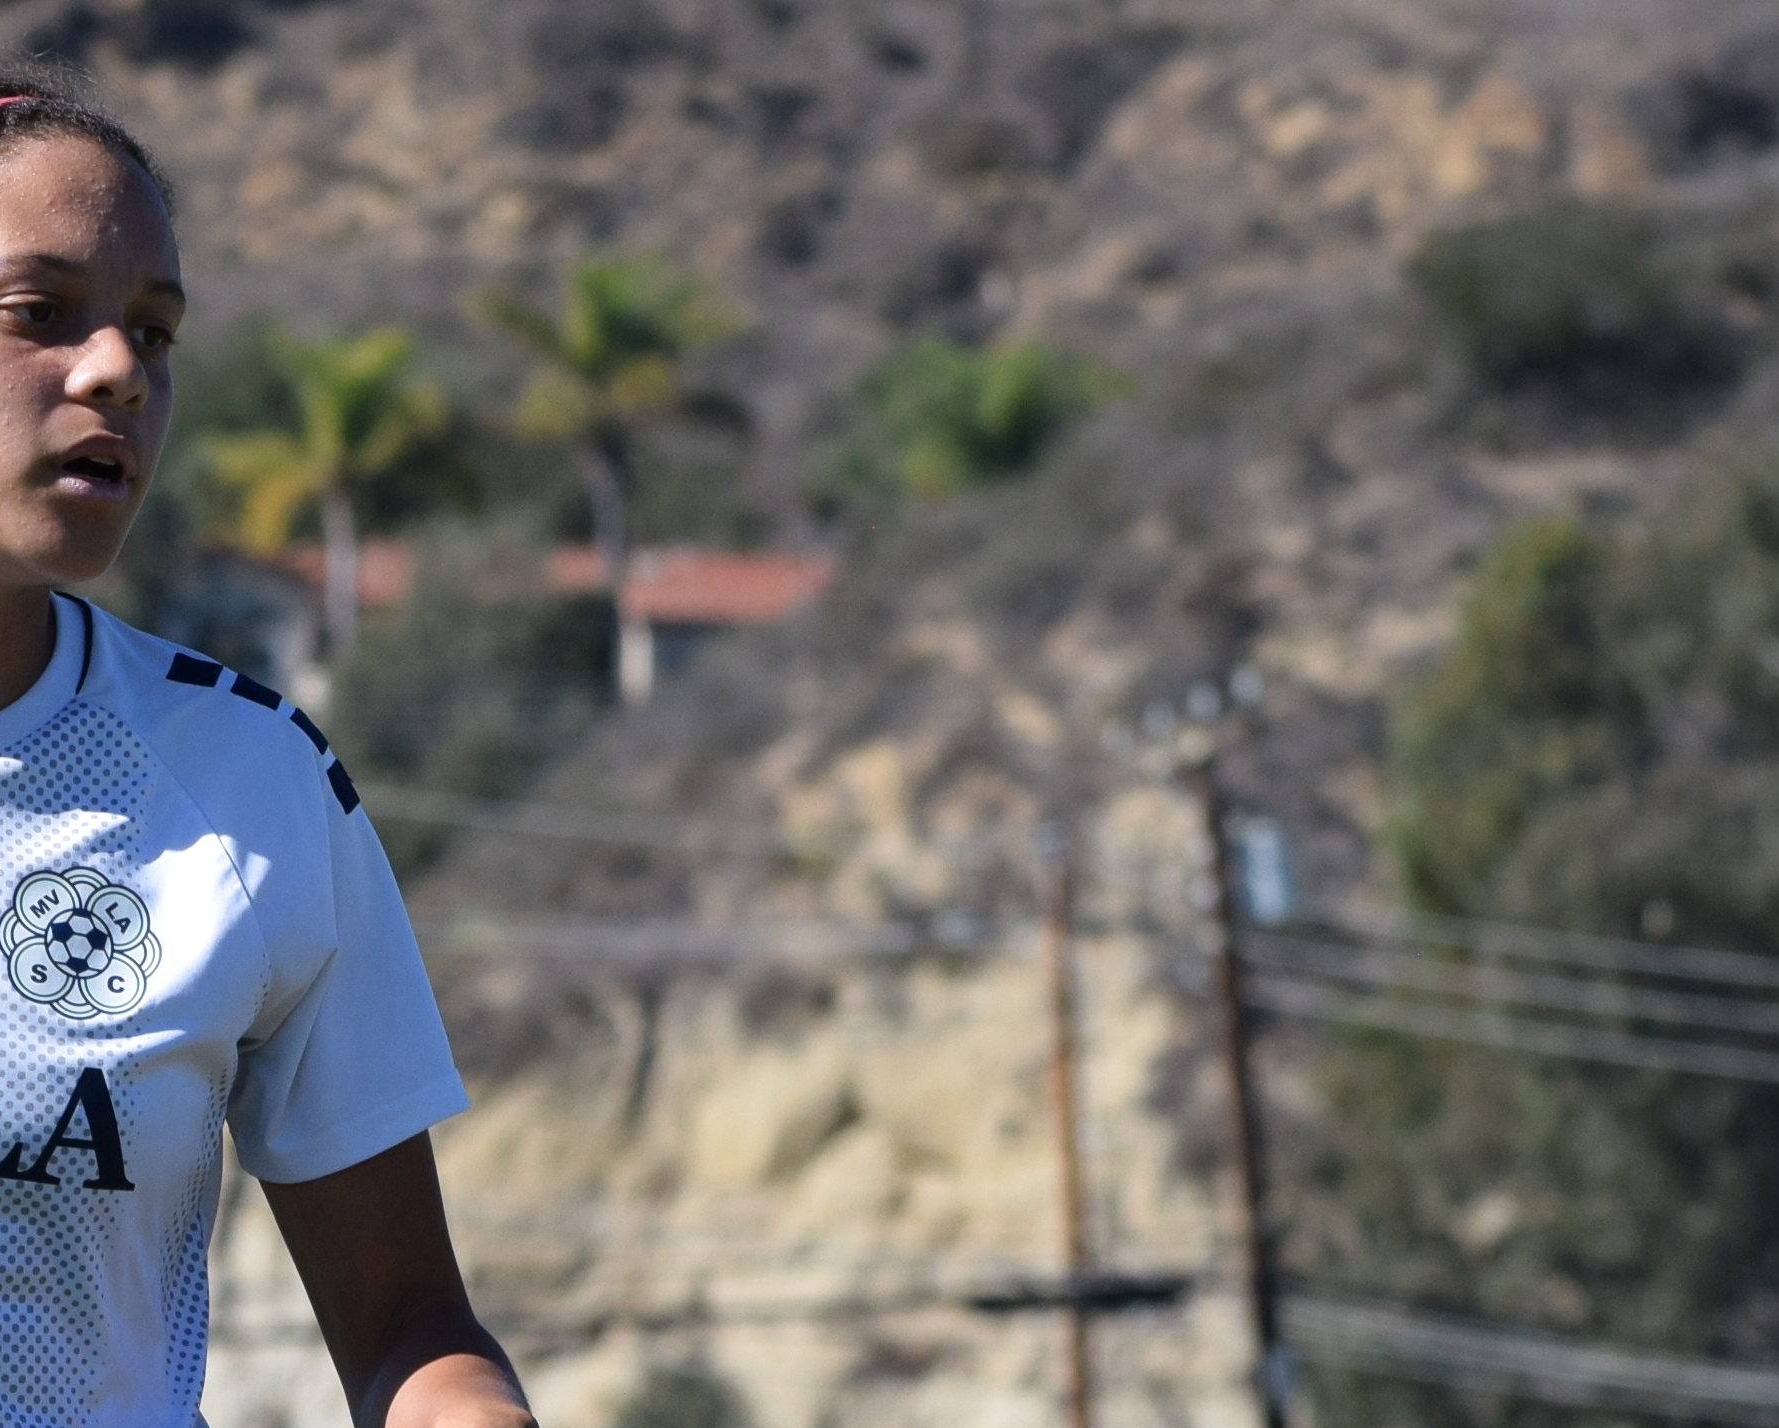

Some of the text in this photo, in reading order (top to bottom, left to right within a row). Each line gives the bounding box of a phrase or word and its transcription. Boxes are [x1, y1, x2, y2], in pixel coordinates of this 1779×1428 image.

[29, 889, 60, 919] MV
[105, 902, 132, 935] LA
[30, 964, 48, 984] S
[107, 975, 125, 994] C
